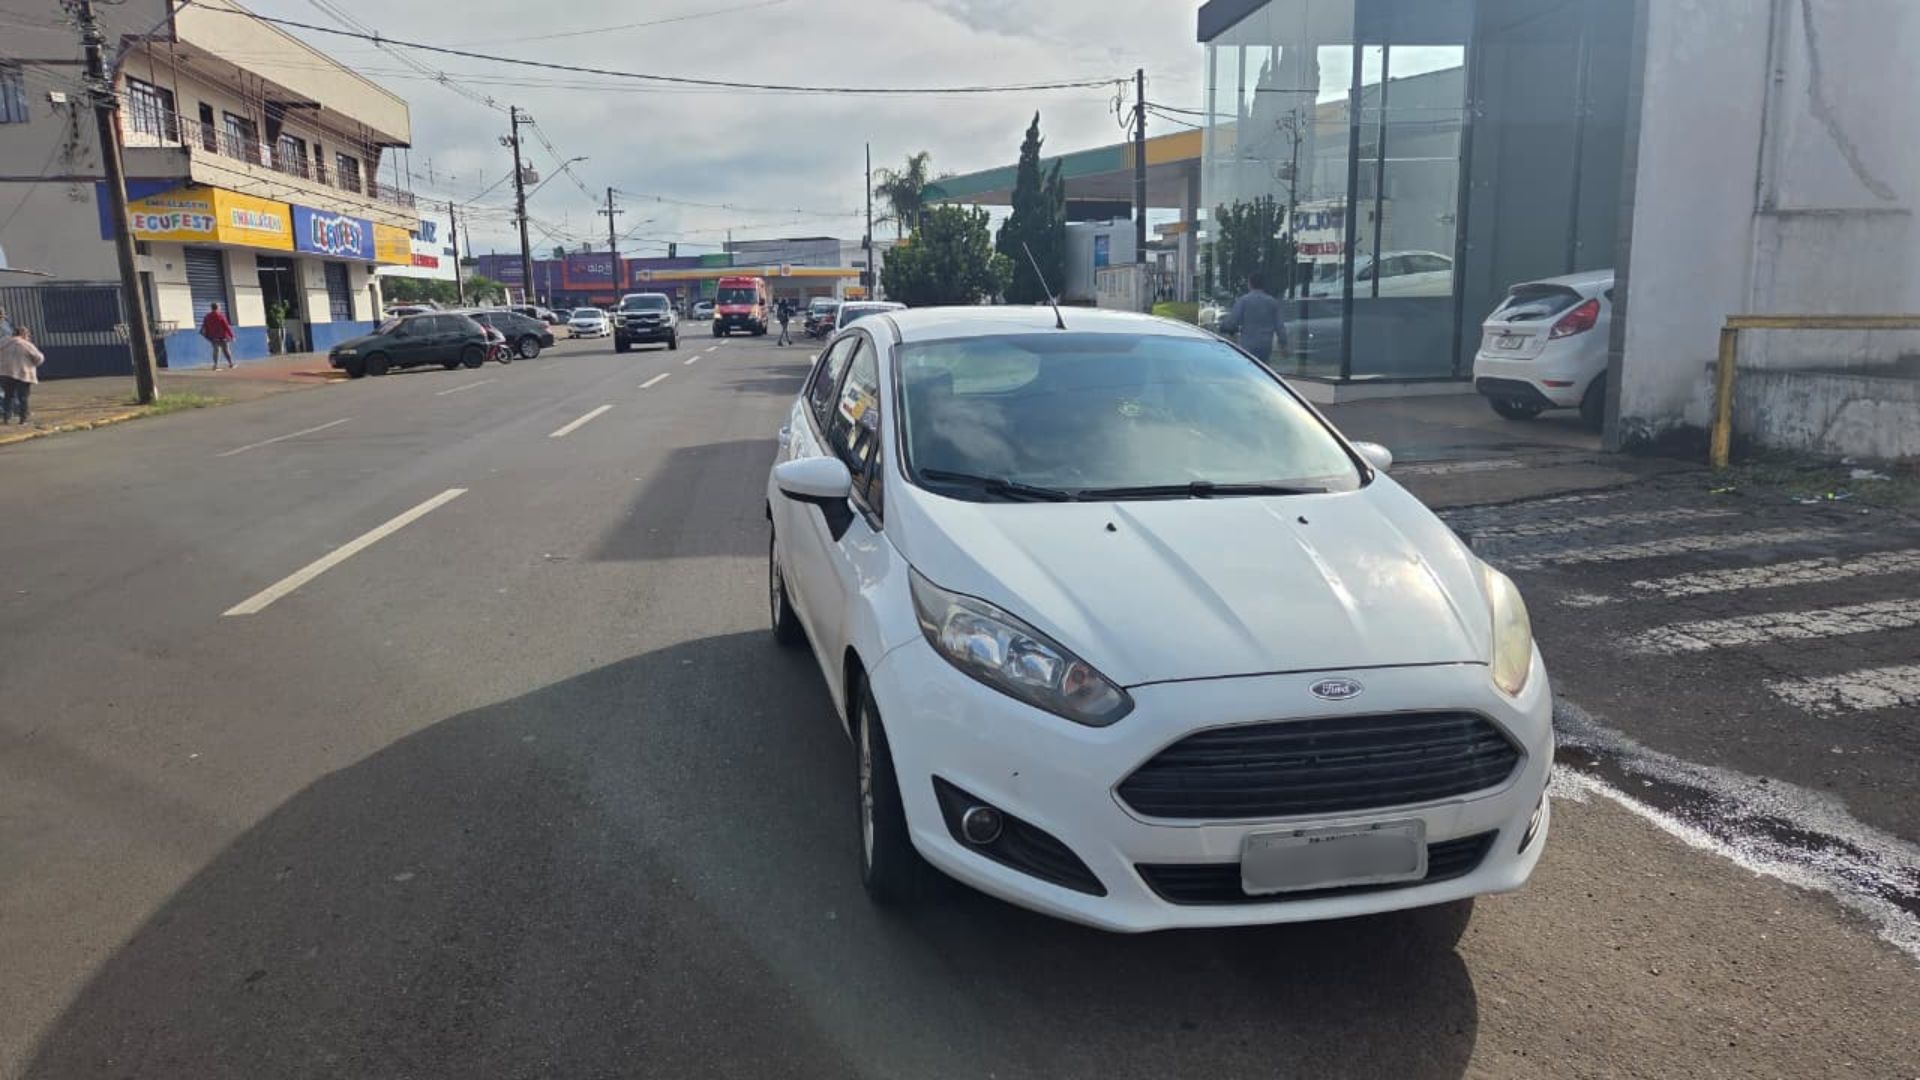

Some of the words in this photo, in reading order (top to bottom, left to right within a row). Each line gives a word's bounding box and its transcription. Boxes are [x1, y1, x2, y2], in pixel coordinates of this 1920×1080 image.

[131, 211, 216, 233] EGUFEST
[311, 212, 362, 255] LEGUFEST
[1322, 682, 1350, 694] Ford
